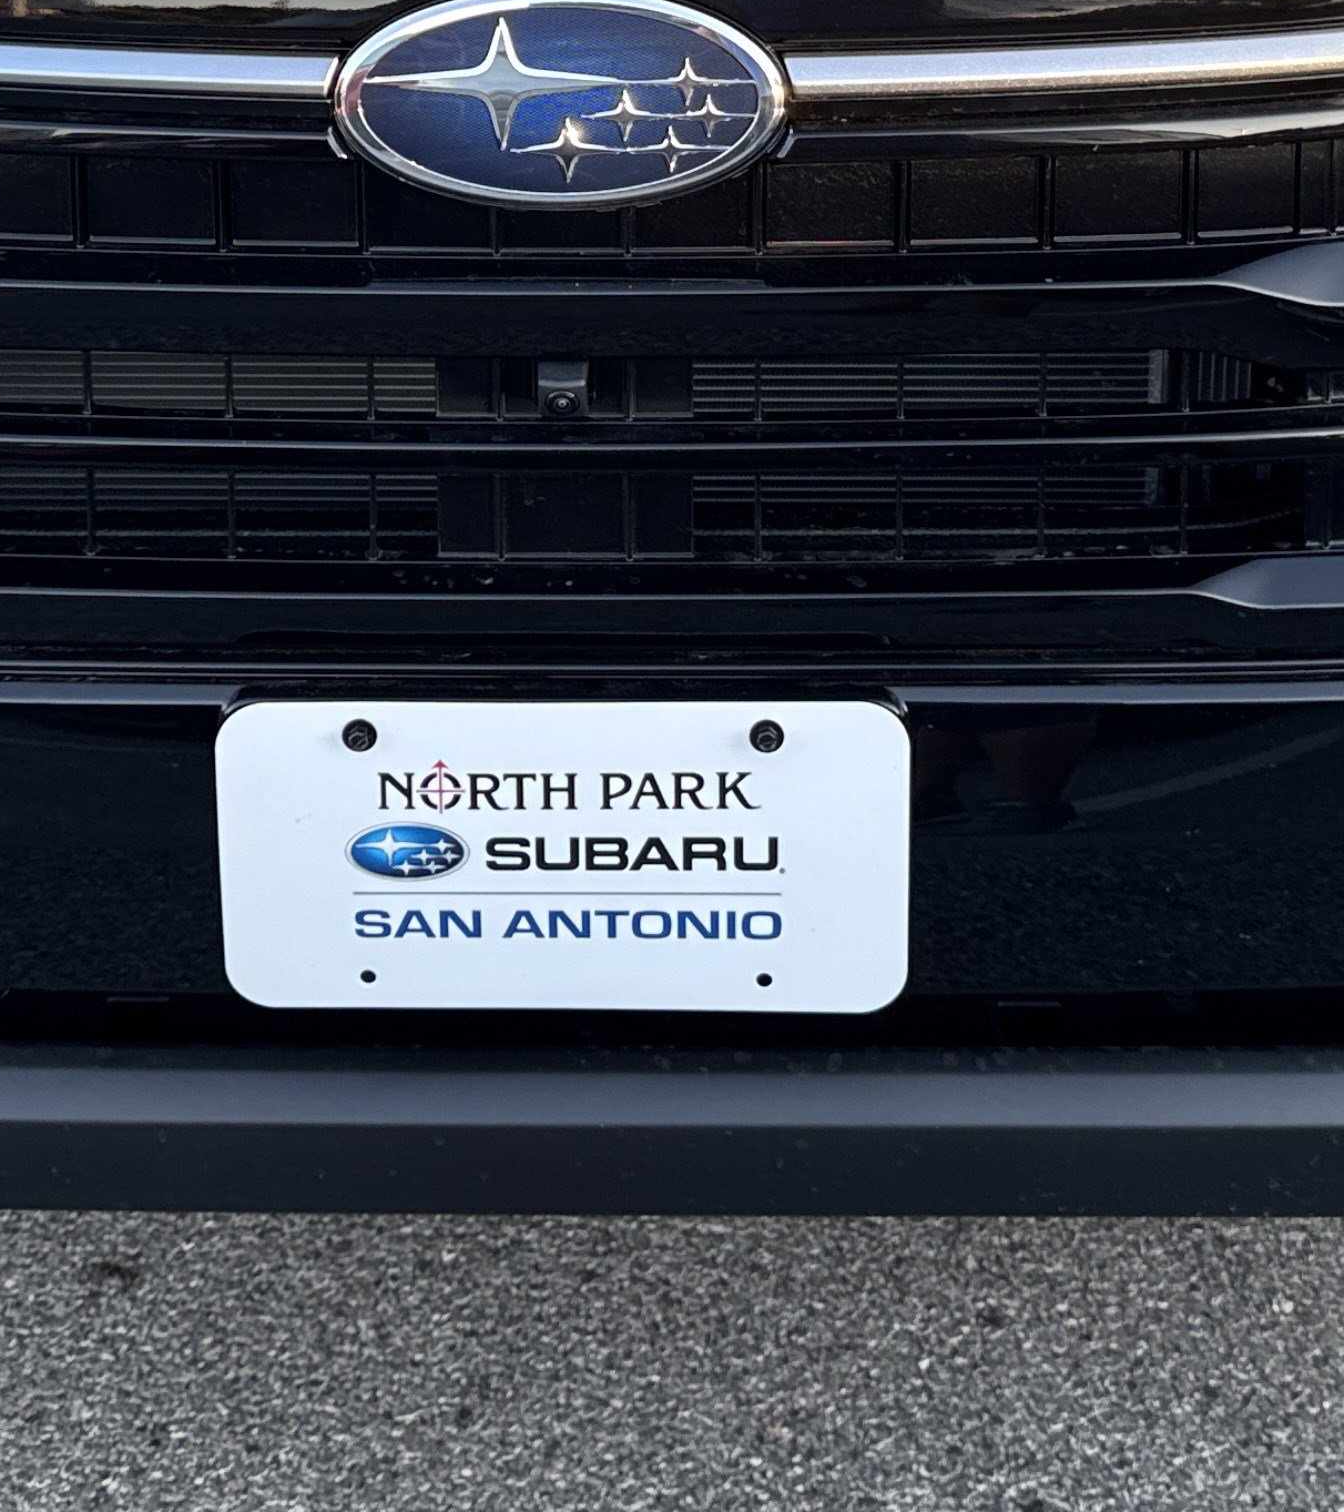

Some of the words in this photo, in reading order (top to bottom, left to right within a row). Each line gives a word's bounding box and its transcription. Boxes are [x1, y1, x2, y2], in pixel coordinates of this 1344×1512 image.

[377, 768, 578, 813] NORTH
[599, 771, 763, 811] PARK
[485, 835, 780, 872] SUBARU
[353, 909, 483, 940] SAN
[502, 909, 783, 941] ANTONIO
